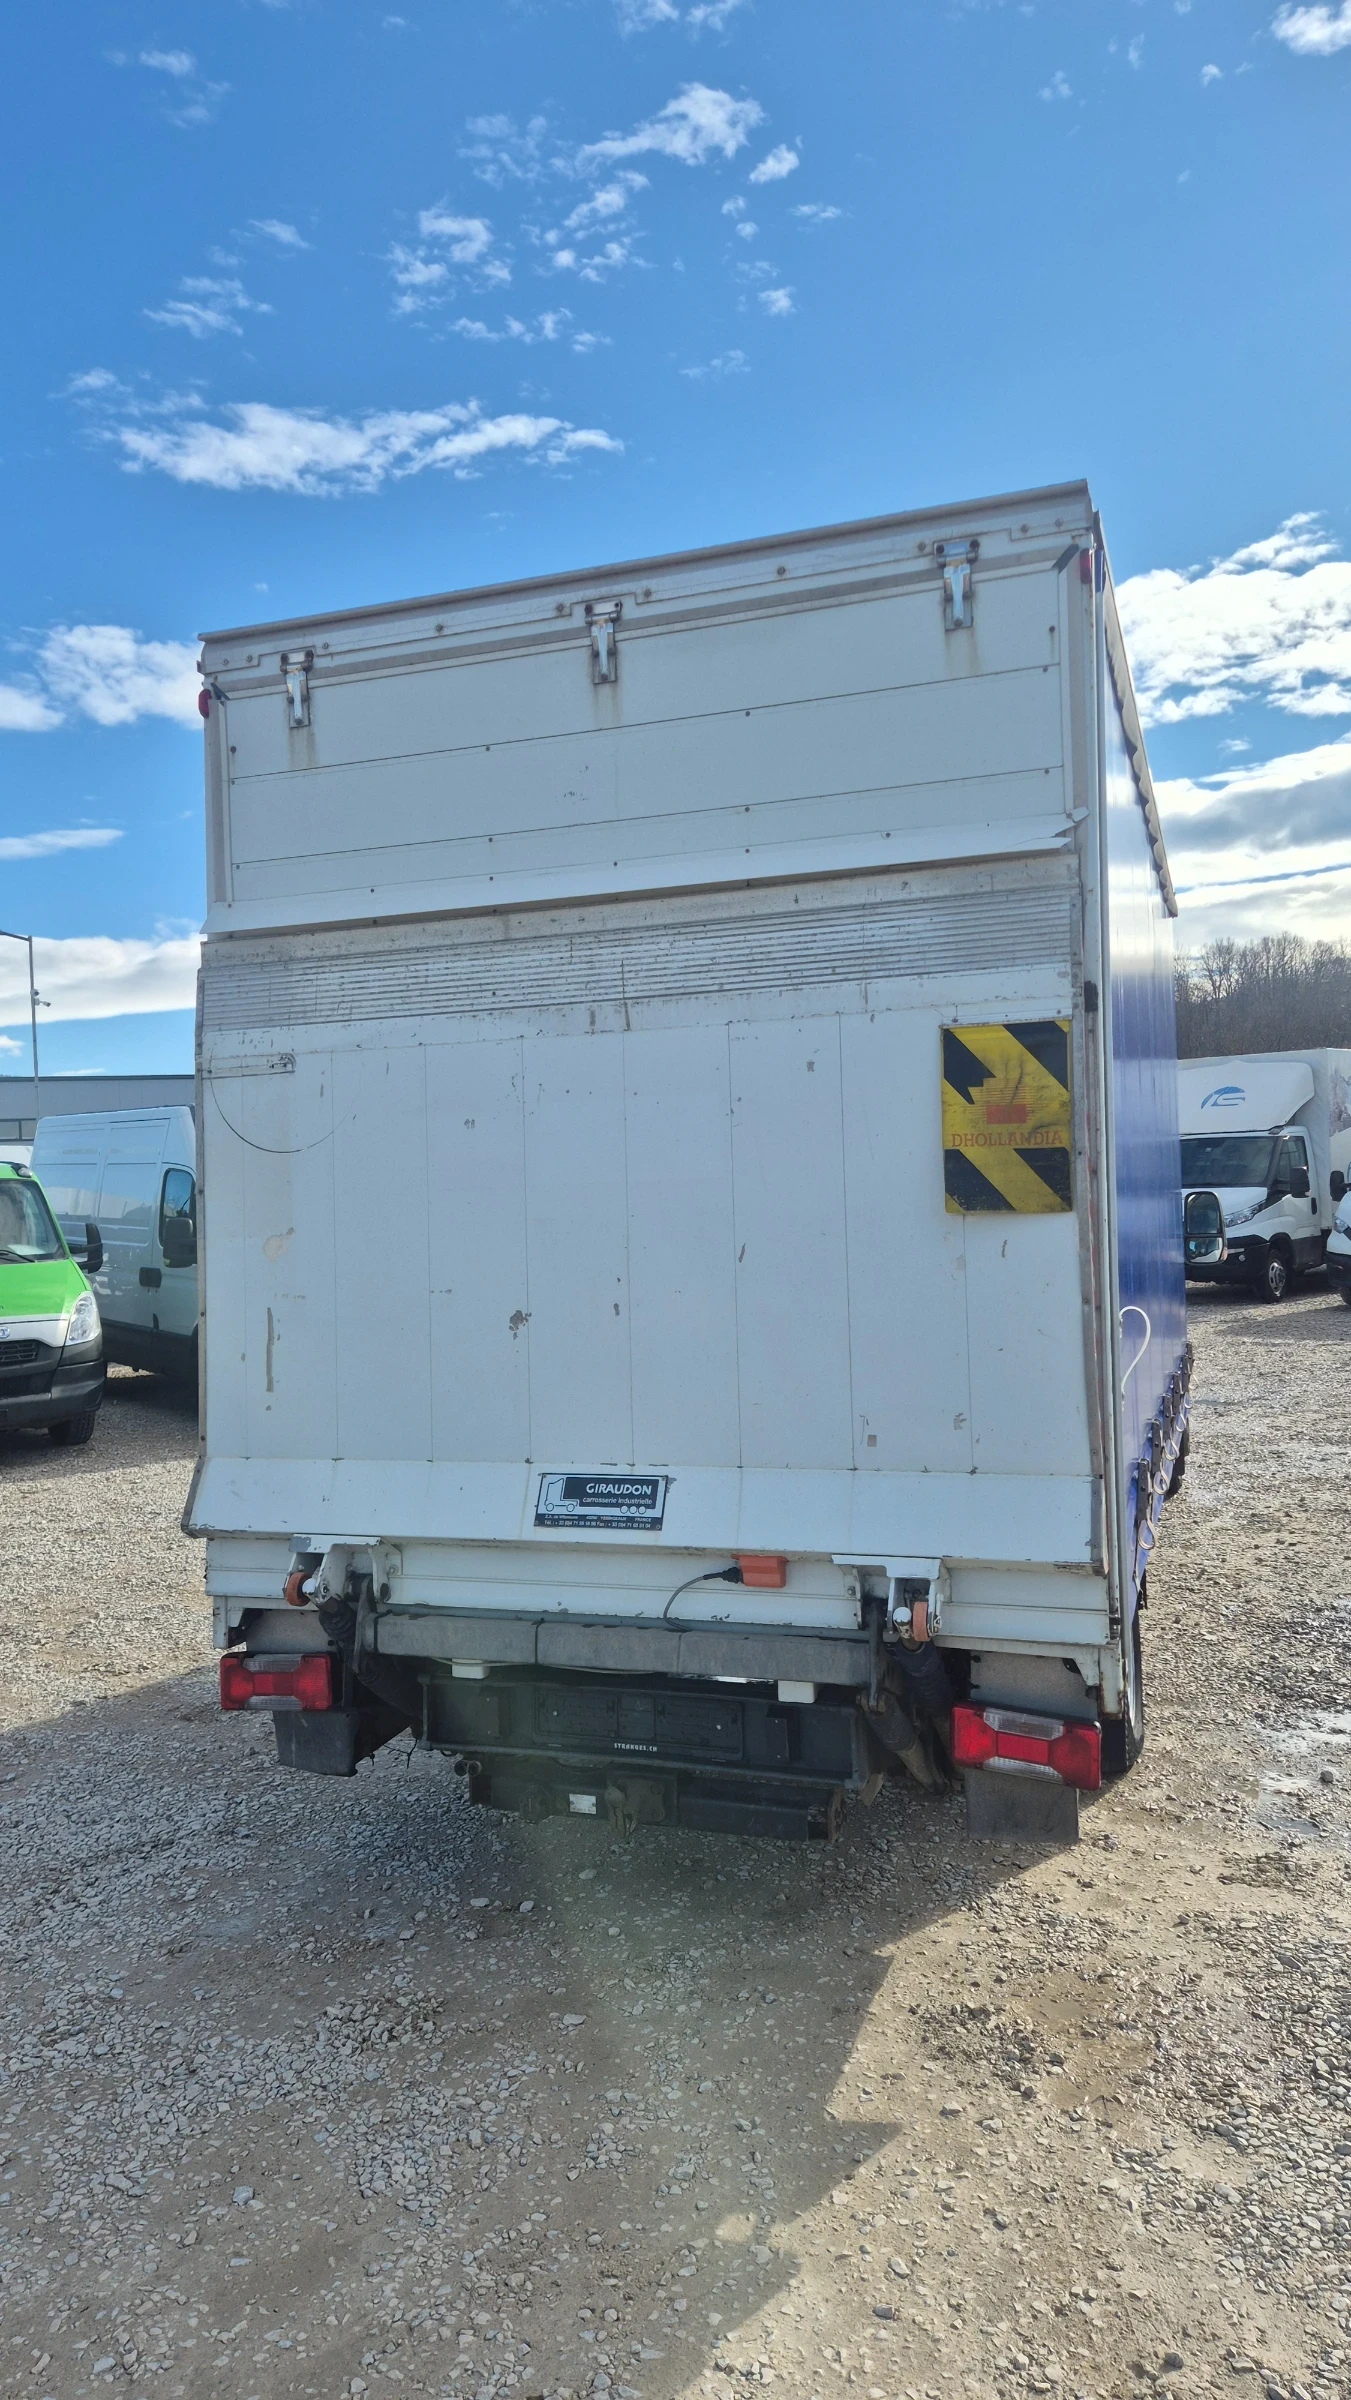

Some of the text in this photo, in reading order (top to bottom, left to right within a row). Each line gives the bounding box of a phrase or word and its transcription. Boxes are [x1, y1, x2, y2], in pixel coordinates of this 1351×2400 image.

[951, 1130, 1063, 1147] DHOLLANDIA
[586, 1483, 652, 1495] GIRAUDON
[618, 1497, 653, 1505] industrielle
